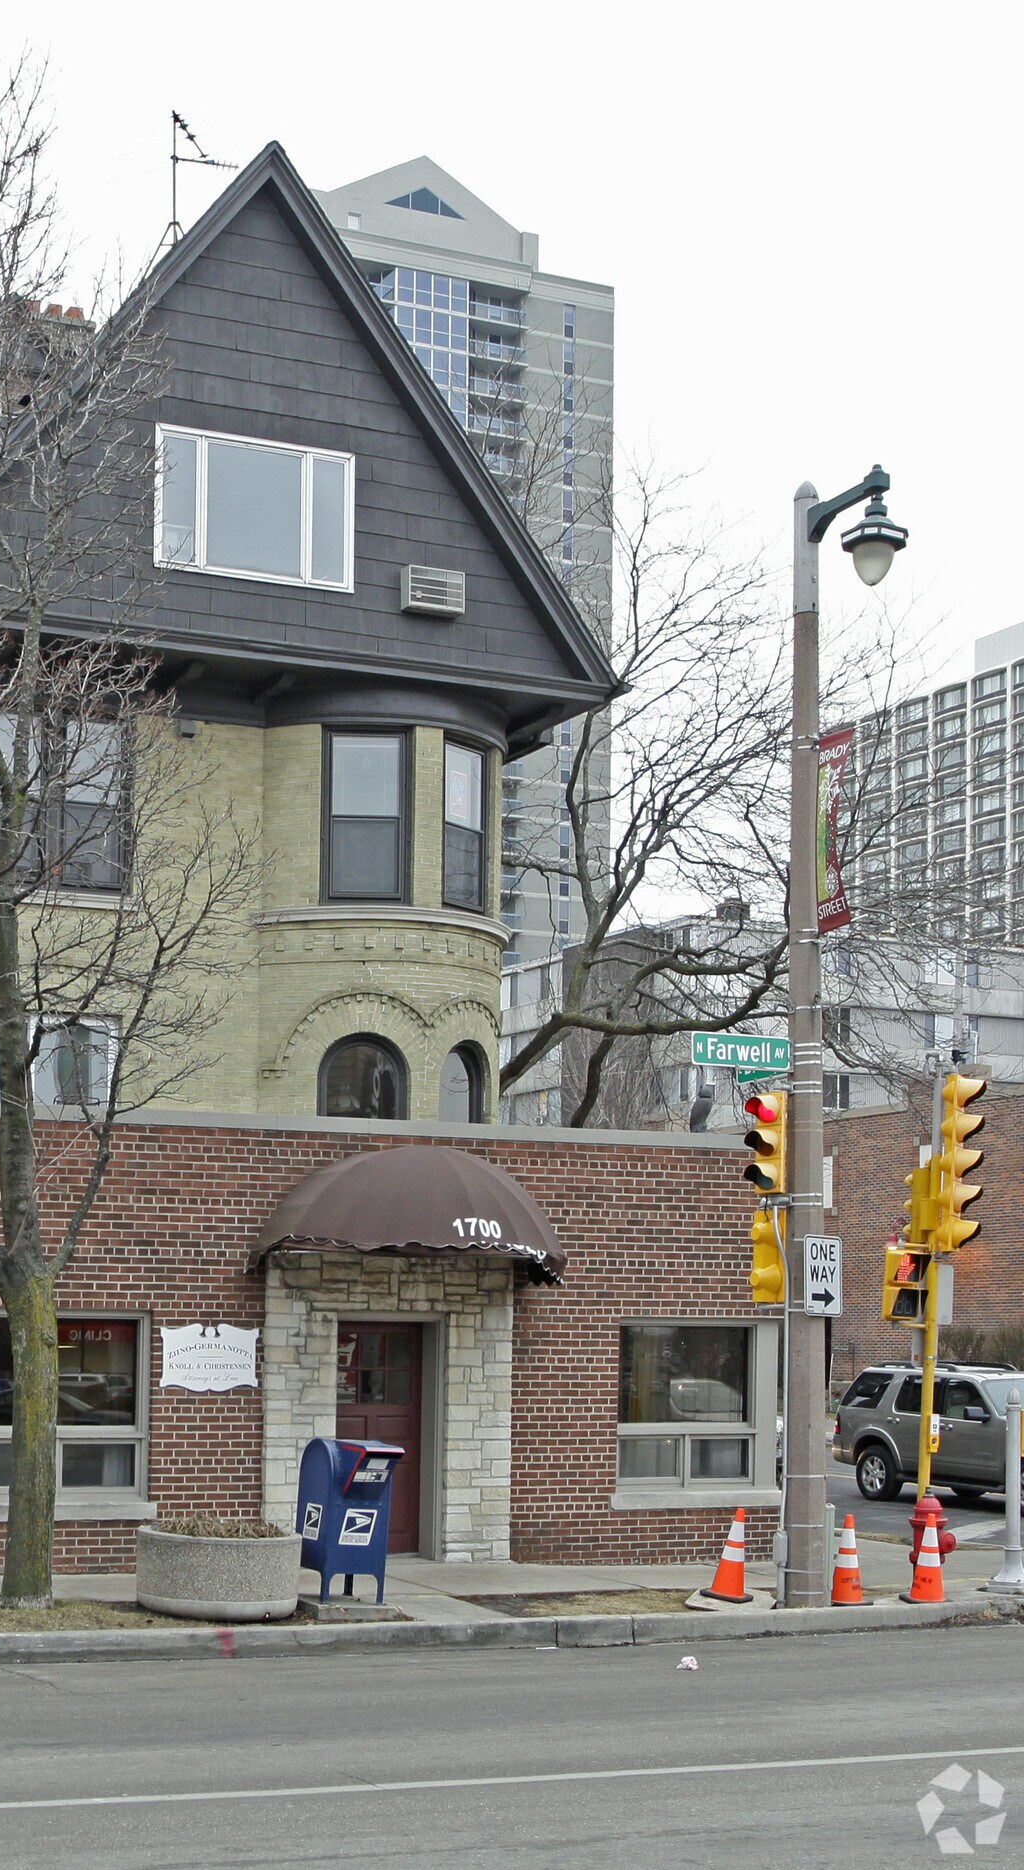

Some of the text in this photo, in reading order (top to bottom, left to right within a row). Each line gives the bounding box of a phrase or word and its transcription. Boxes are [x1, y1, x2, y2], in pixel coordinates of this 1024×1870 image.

[819, 742, 851, 764] BRADY
[818, 896, 846, 920] STREET
[696, 1038, 785, 1063] N Farwell AV
[452, 1217, 501, 1239] 1700
[810, 1242, 836, 1262] ONE
[810, 1264, 836, 1284] WAY
[168, 1362, 194, 1370] KNOLL
[204, 1362, 252, 1370] CHRISTENSEN
[181, 1371, 212, 1383] Attorneys
